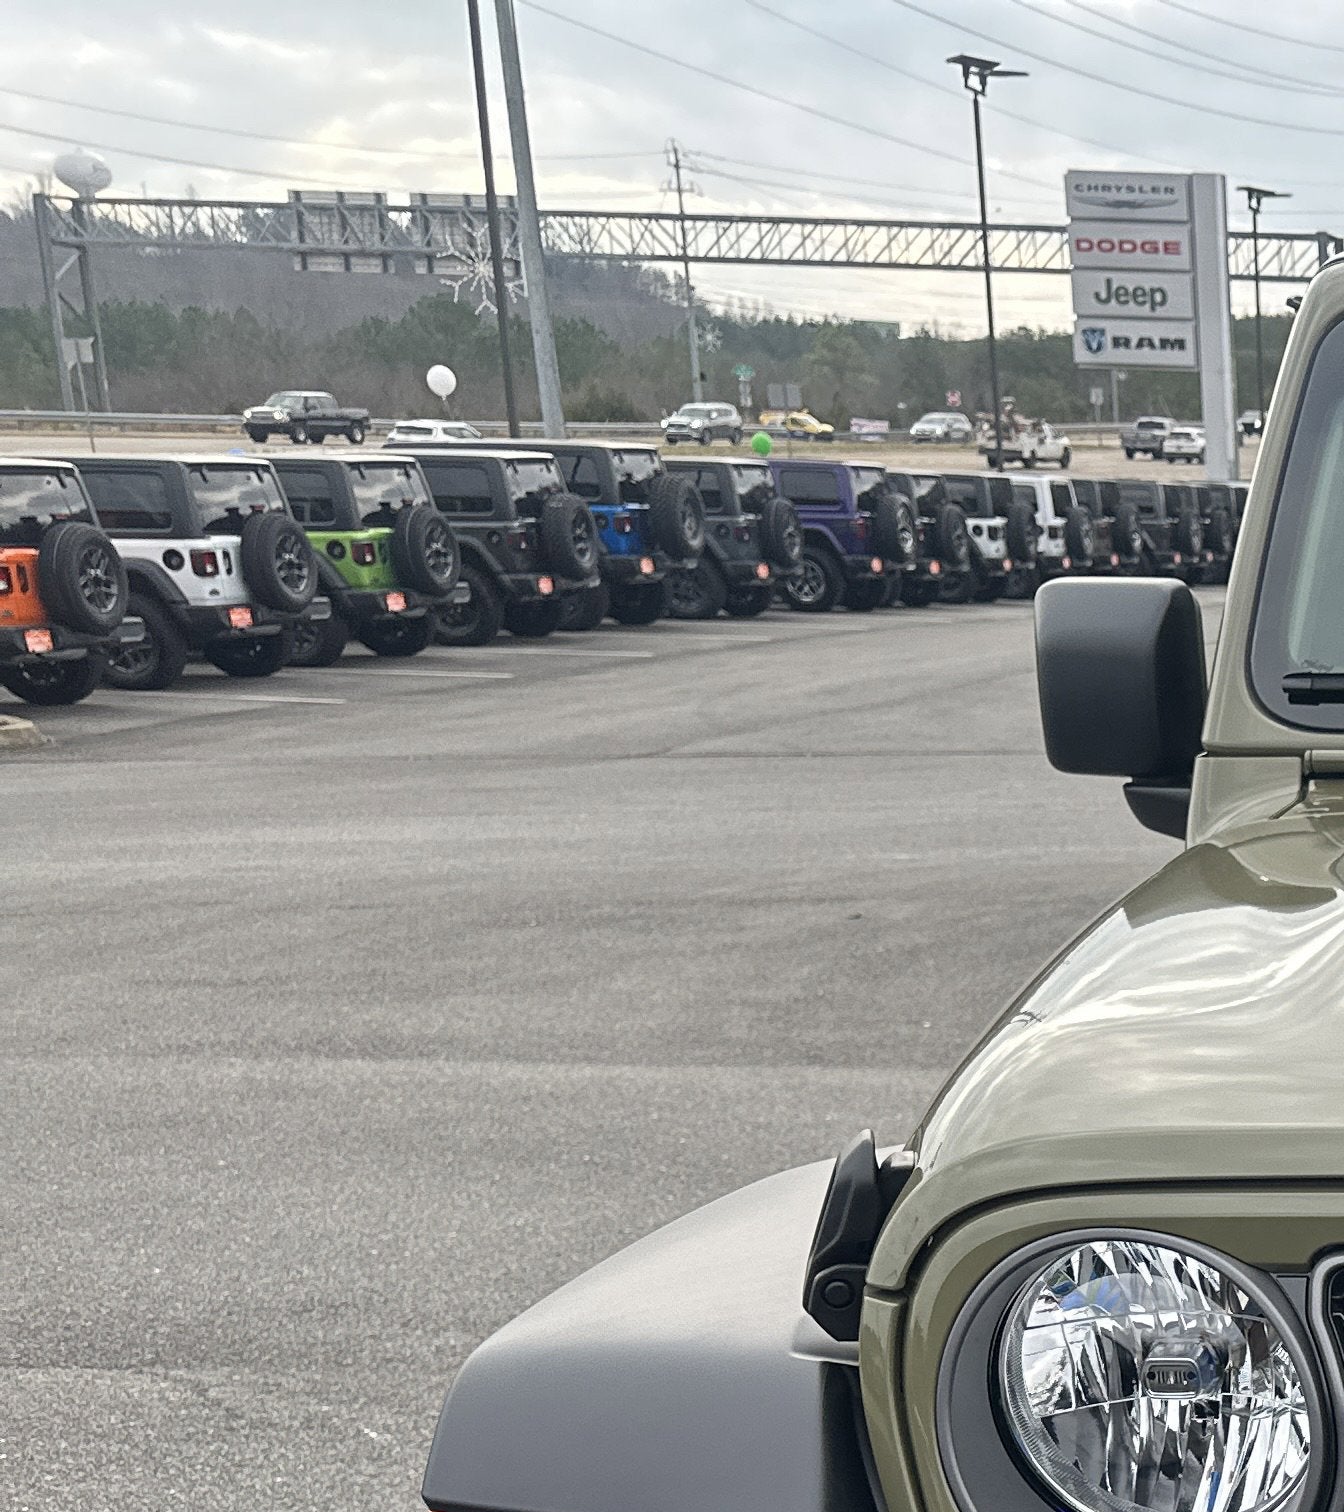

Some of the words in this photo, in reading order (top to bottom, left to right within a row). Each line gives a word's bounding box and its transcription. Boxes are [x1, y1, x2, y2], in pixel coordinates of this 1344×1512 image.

[1073, 183, 1176, 195] CHRYSLER
[1074, 238, 1182, 256] DODGE
[1093, 277, 1169, 313] Jeep
[1111, 335, 1187, 352] RAM
